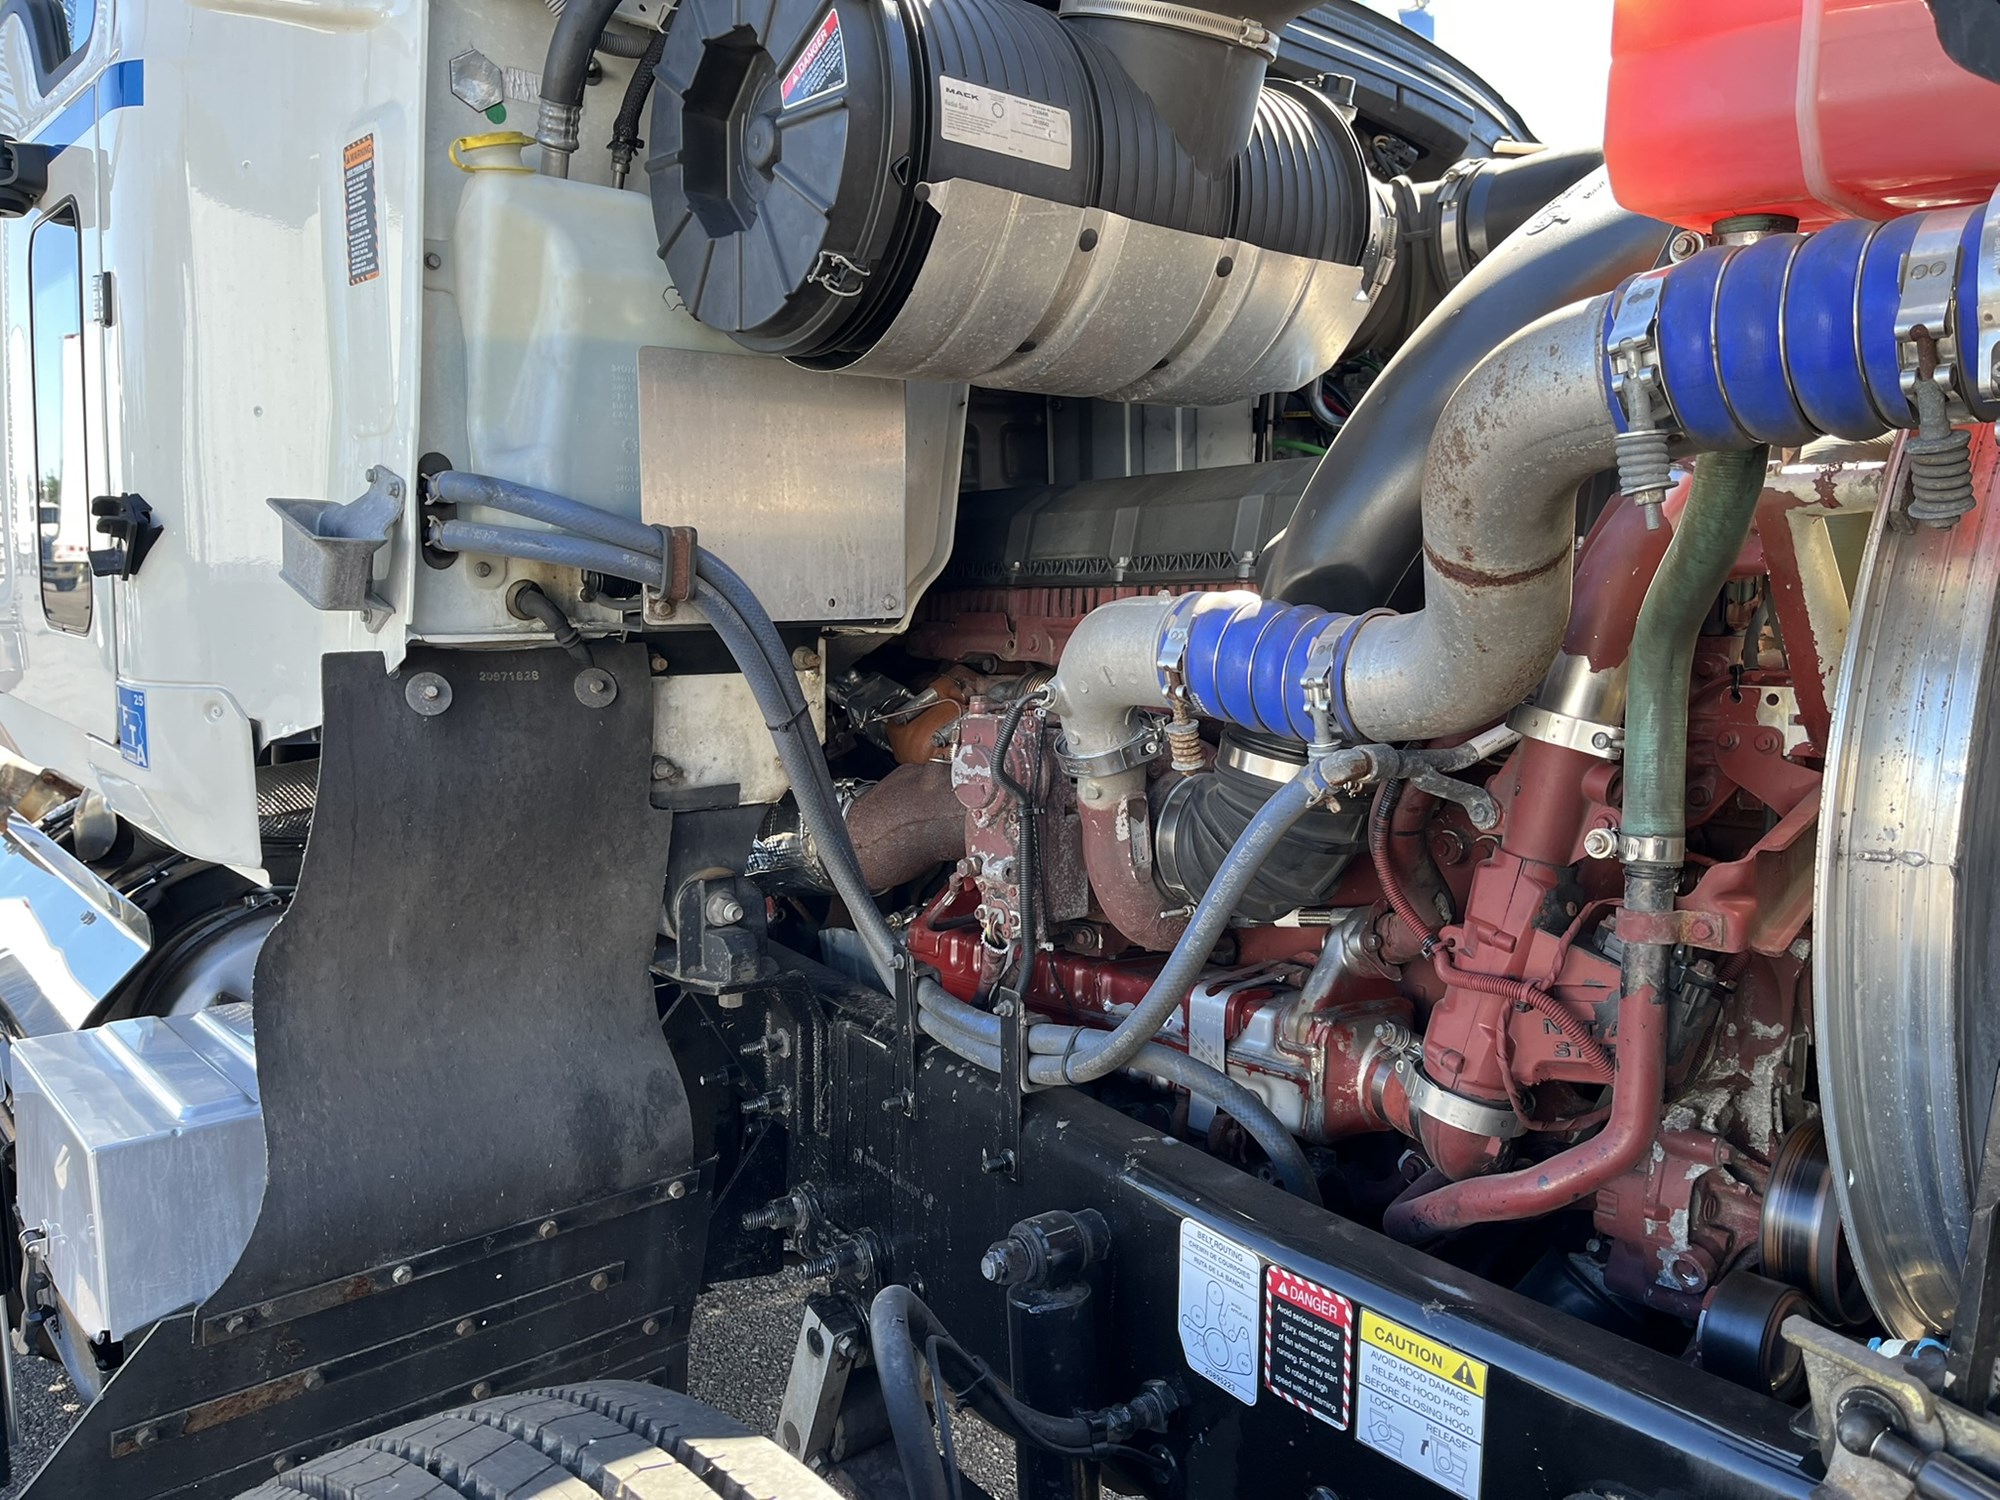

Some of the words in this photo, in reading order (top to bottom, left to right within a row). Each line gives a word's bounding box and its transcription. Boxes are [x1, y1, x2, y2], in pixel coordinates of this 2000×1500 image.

[799, 29, 827, 73] DANGER
[946, 88, 979, 101] MACK
[134, 694, 144, 706] 25
[1189, 1240, 1208, 1256] CHEMIN
[1210, 1252, 1217, 1260] DE
[1218, 1257, 1250, 1280] COURROIES
[1197, 1231, 1212, 1246] BELT
[1214, 1240, 1243, 1262] ROUTING
[1194, 1257, 1207, 1268] RUTA
[1209, 1264, 1216, 1274] DE
[1217, 1269, 1224, 1278] LA
[1225, 1274, 1244, 1290] BANDA
[1290, 1286, 1338, 1319] DANGER
[1277, 1304, 1292, 1317] Avoid
[1293, 1313, 1313, 1328] serious
[1314, 1324, 1339, 1340] personal
[1285, 1336, 1293, 1346] fan
[1294, 1342, 1309, 1355] when
[1311, 1351, 1330, 1365] engine
[1331, 1359, 1336, 1368] is
[1299, 1330, 1318, 1344] remain
[1319, 1340, 1334, 1352] clear
[1374, 1327, 1442, 1368] CAUTION
[1285, 1364, 1290, 1373] to
[1292, 1369, 1307, 1382] rotate
[1308, 1378, 1314, 1386] at
[1315, 1380, 1328, 1393] high
[1299, 1358, 1310, 1369] Fan
[1311, 1365, 1323, 1377] may
[1324, 1372, 1338, 1384] start
[1371, 1350, 1397, 1368] AVOID
[1400, 1364, 1426, 1383] HOOD
[1429, 1378, 1471, 1406] DAMAGE.
[1275, 1374, 1291, 1388] speed
[1292, 1384, 1312, 1399] without
[1313, 1396, 1337, 1414] warning.
[1365, 1375, 1399, 1399] BEFORE
[1402, 1394, 1443, 1420] CLOSING
[1445, 1415, 1475, 1438] HOOD.
[1370, 1394, 1394, 1413] LOCK
[1372, 1364, 1411, 1390] RELEASE
[1414, 1386, 1440, 1404] HOOD
[1443, 1400, 1470, 1417] PROP
[1426, 1424, 1468, 1452] RELEASE
